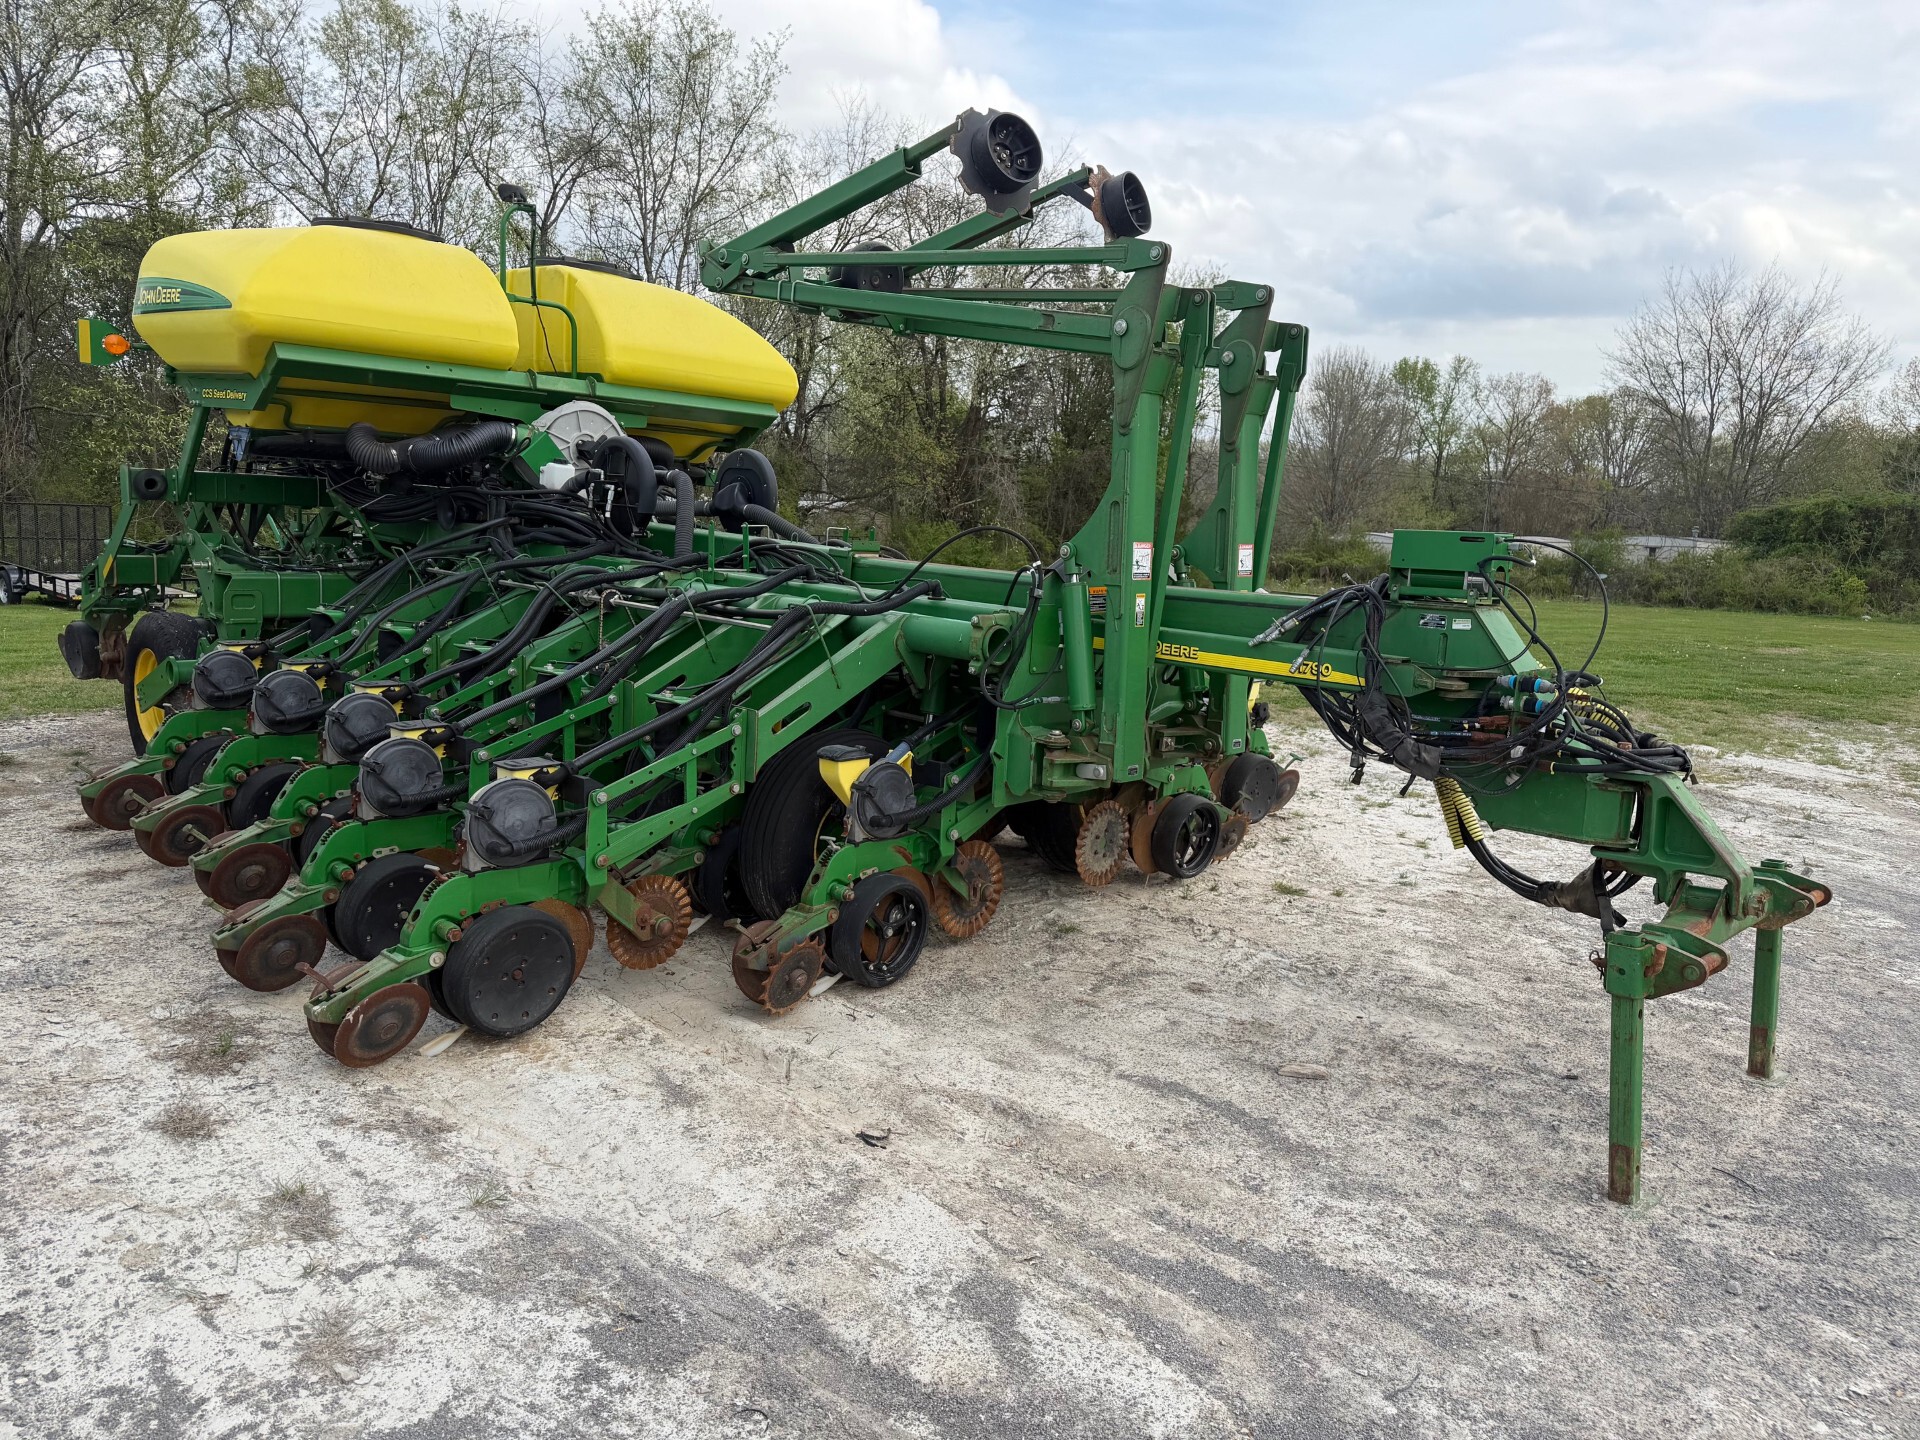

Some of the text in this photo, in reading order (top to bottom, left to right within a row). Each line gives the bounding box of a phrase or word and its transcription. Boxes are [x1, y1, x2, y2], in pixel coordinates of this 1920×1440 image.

[138, 286, 181, 305] JOHN DEERE
[202, 388, 213, 398] CCS
[213, 389, 226, 399] Seed
